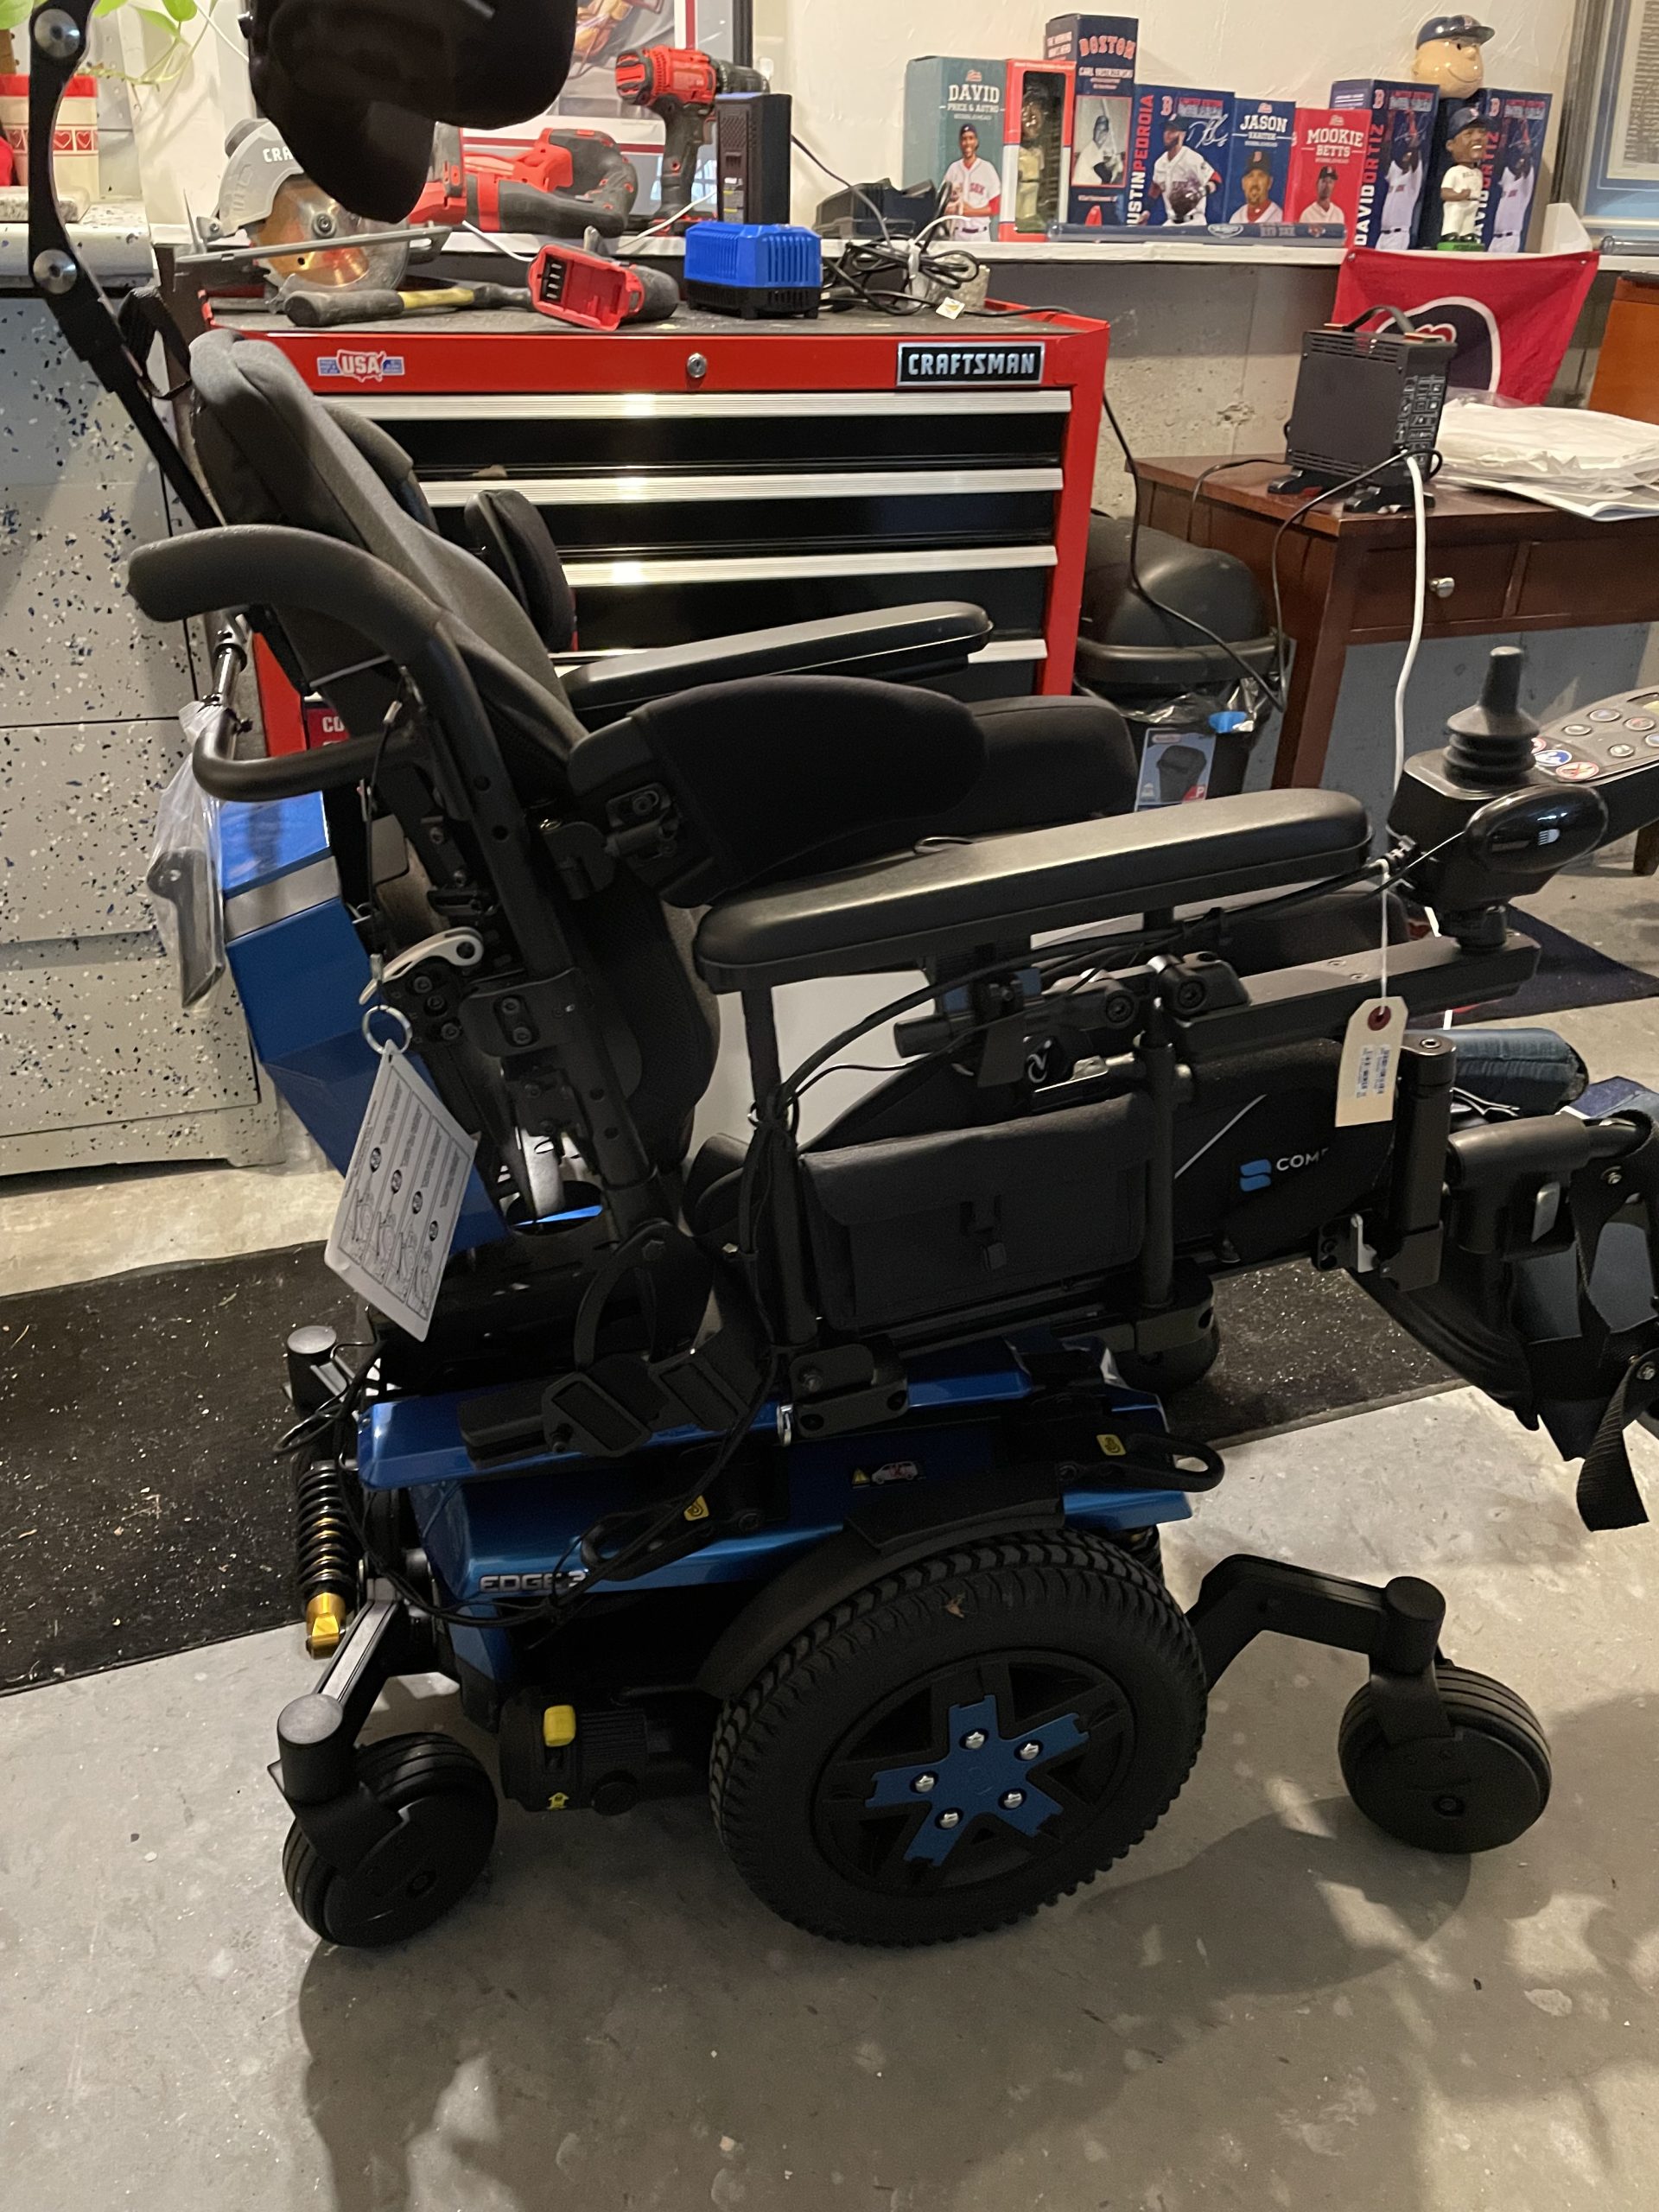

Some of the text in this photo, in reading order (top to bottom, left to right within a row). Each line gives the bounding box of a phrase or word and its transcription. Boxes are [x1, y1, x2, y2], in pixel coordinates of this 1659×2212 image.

[1078, 35, 1136, 60] BOSTON
[948, 84, 1000, 104] DAVID
[1239, 114, 1287, 133] JASON
[1306, 128, 1364, 148] MOOKIE
[1316, 144, 1351, 157] BETTS
[341, 355, 380, 374] USA
[907, 353, 1035, 375] CRAFTSMAN
[480, 1573, 563, 1592] EDGE
